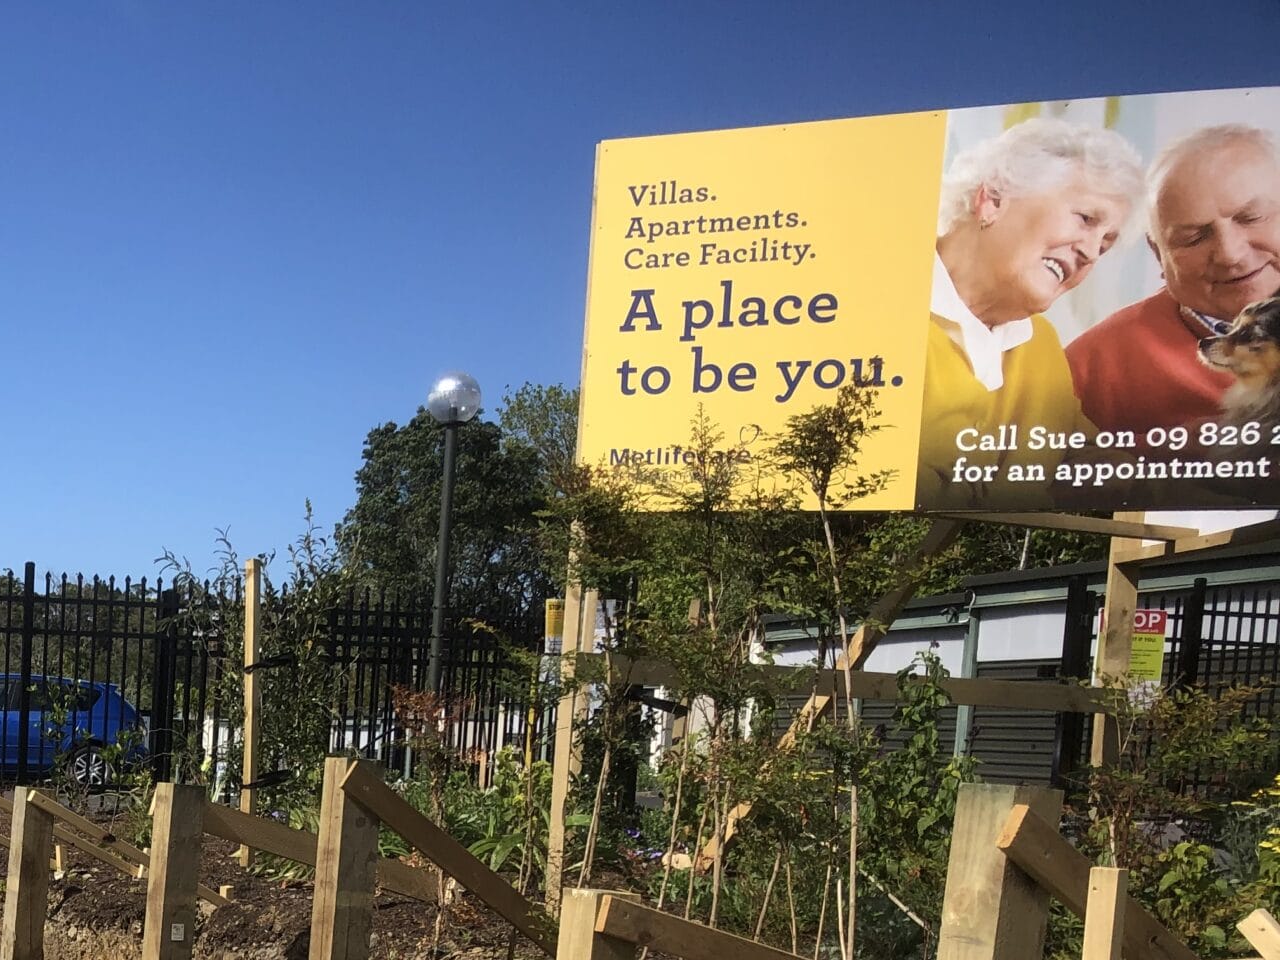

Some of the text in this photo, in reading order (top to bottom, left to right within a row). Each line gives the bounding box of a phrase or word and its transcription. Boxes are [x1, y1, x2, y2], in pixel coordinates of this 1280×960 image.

[627, 180, 718, 207] Villas.
[624, 209, 808, 243] Apartments.
[624, 237, 817, 270] Care Facility.
[619, 279, 839, 342] A place
[616, 346, 904, 403] to be you.
[955, 424, 1019, 452] Call
[1027, 425, 1087, 450] Sue
[1095, 430, 1136, 449] on
[1146, 426, 1189, 451] 09
[1198, 421, 1261, 446] 826
[951, 455, 1272, 487] for an appointment
[1134, 611, 1162, 628] OP
